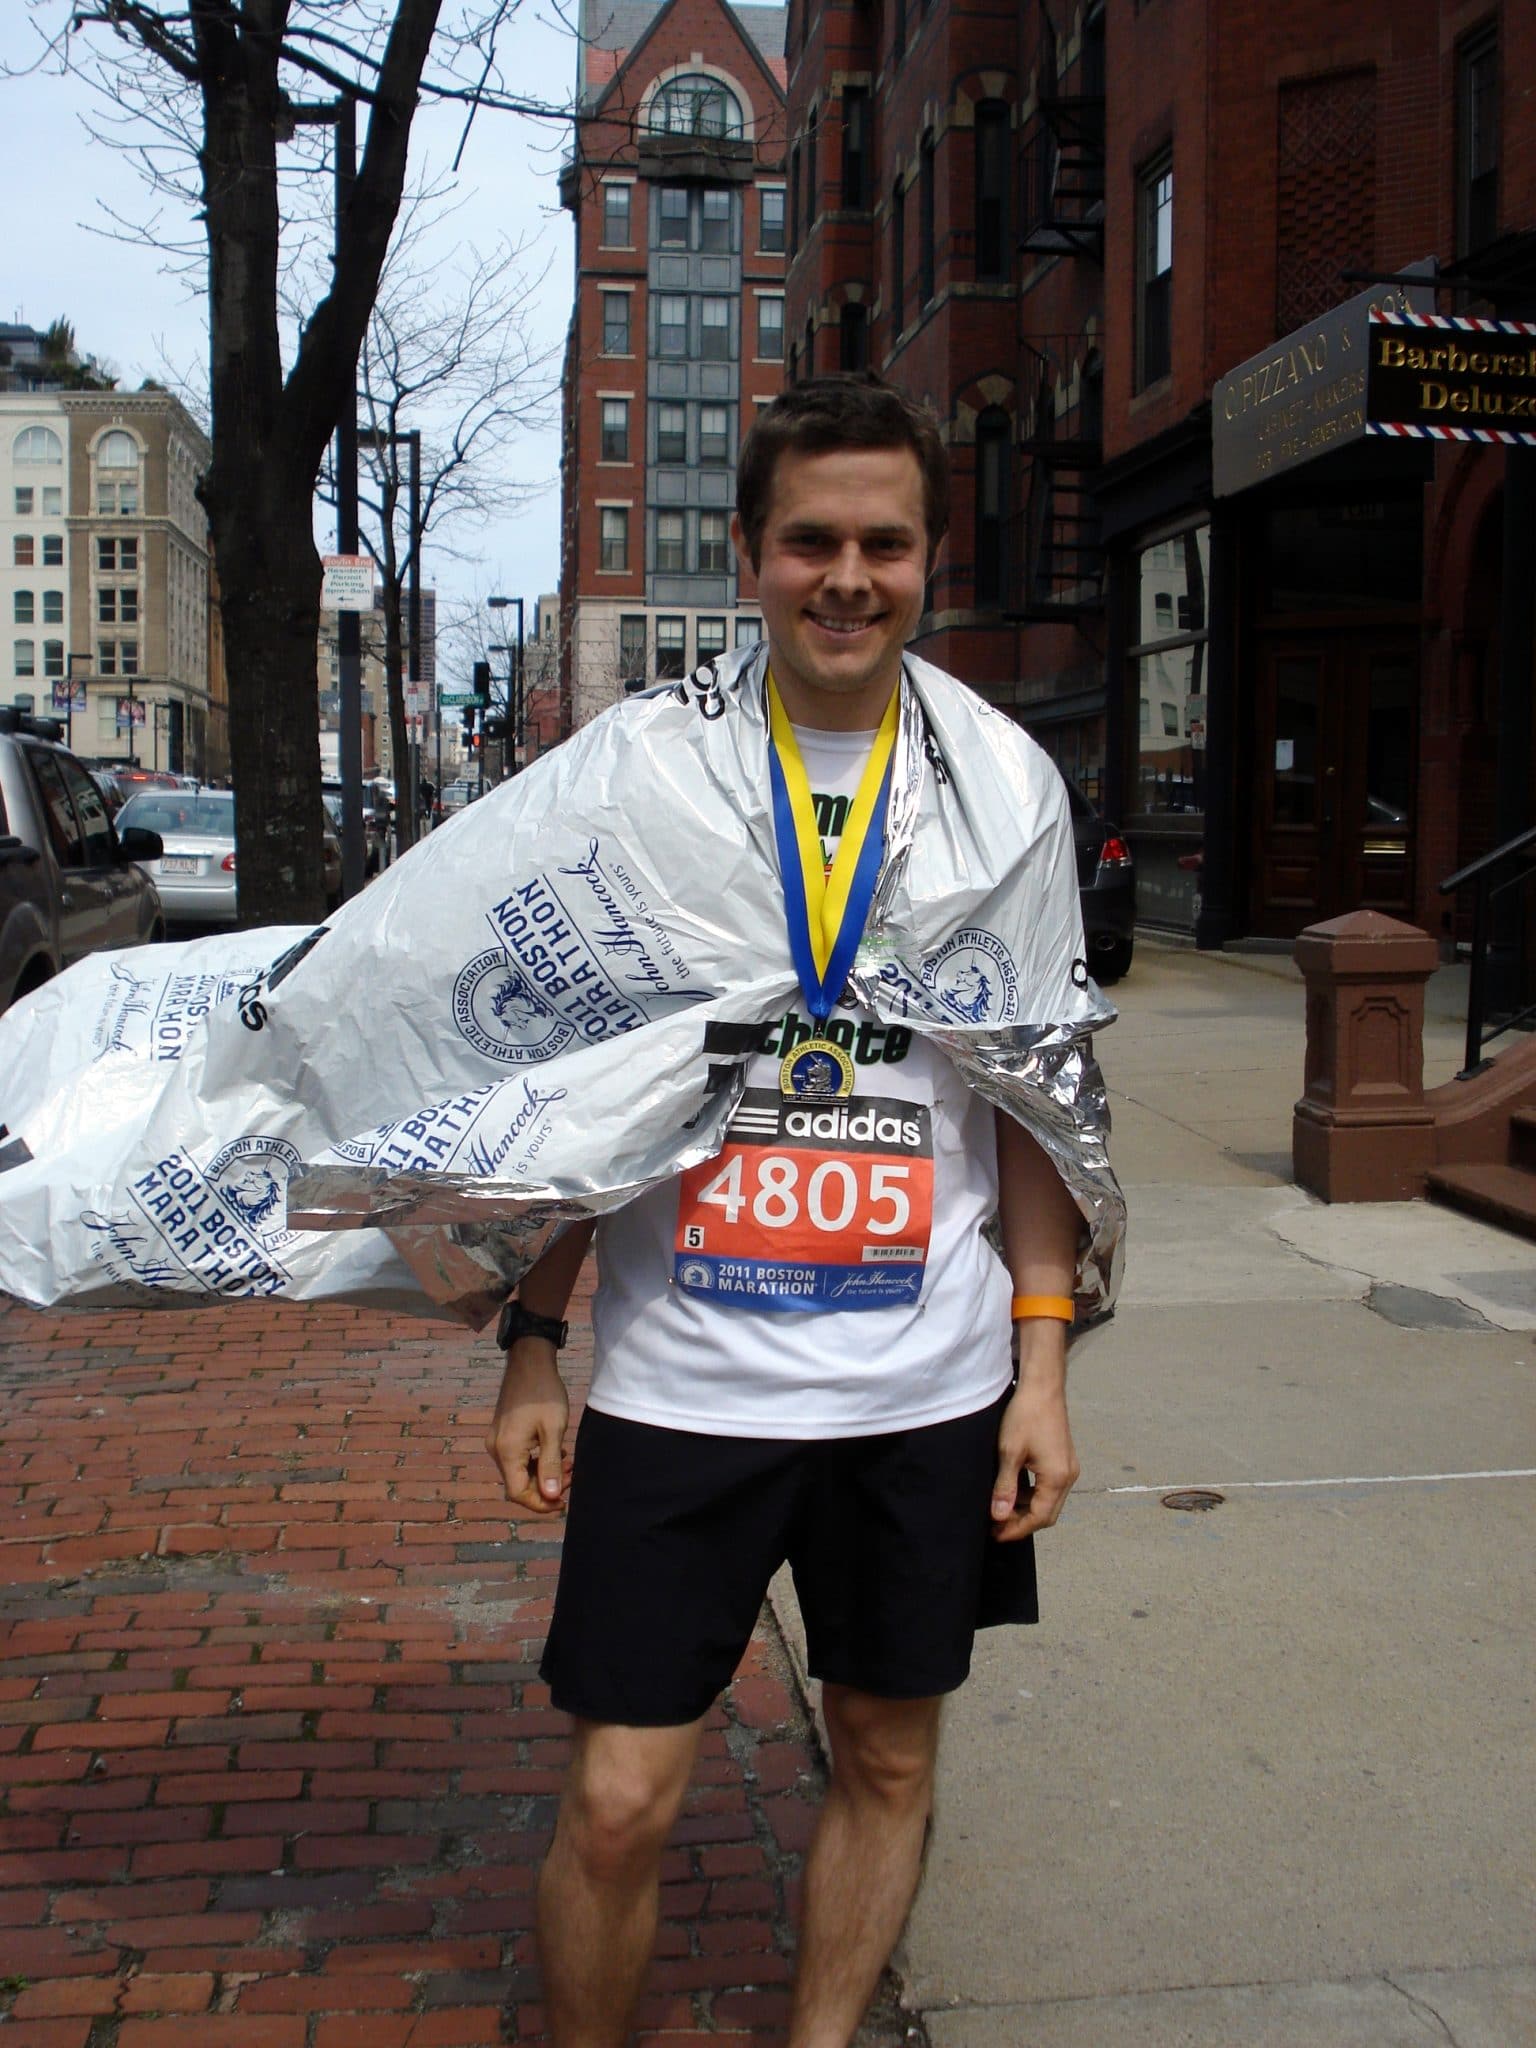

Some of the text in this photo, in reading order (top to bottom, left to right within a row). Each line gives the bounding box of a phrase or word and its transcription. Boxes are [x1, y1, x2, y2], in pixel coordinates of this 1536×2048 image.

[612, 864, 691, 980] the future is yours
[492, 896, 571, 999] BOSTON
[957, 933, 1005, 961] ATHLETIC
[456, 951, 570, 1060] BOSTON ATHLETIC ASSOCIATION
[781, 1043, 851, 1092] BOSTON ATHLETIC ASSOCIATION
[524, 1126, 553, 1161] yours
[785, 1106, 921, 1147] adidas
[210, 1140, 251, 1174] BOSTON
[697, 1154, 910, 1236] 4805
[80, 1210, 148, 1261] John
[156, 1154, 210, 1216] 2011
[200, 1208, 287, 1297] BOSTON
[688, 1228, 700, 1247] 5
[718, 1264, 750, 1279] 2011
[756, 1267, 816, 1281] BOSTON
[718, 1278, 815, 1295] MARATHON
[830, 1270, 917, 1297] John Hancock
